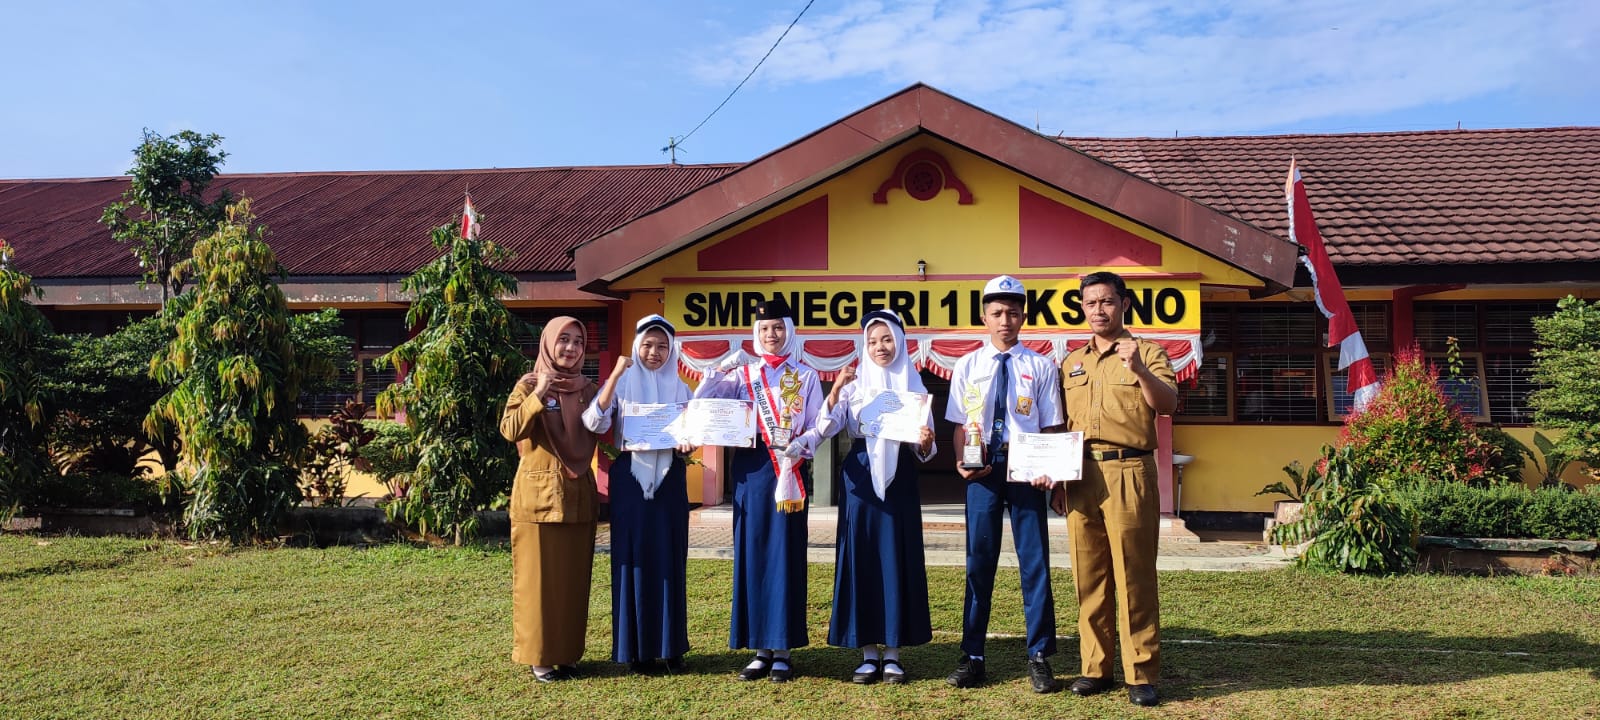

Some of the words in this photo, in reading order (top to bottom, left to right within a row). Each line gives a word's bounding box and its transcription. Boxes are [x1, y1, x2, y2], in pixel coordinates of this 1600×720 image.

[683, 291, 765, 327] SMP
[772, 290, 930, 327] NEGERI
[940, 290, 958, 326] 1
[970, 287, 1186, 326] LKSNO
[754, 381, 771, 416] PENGIBAR
